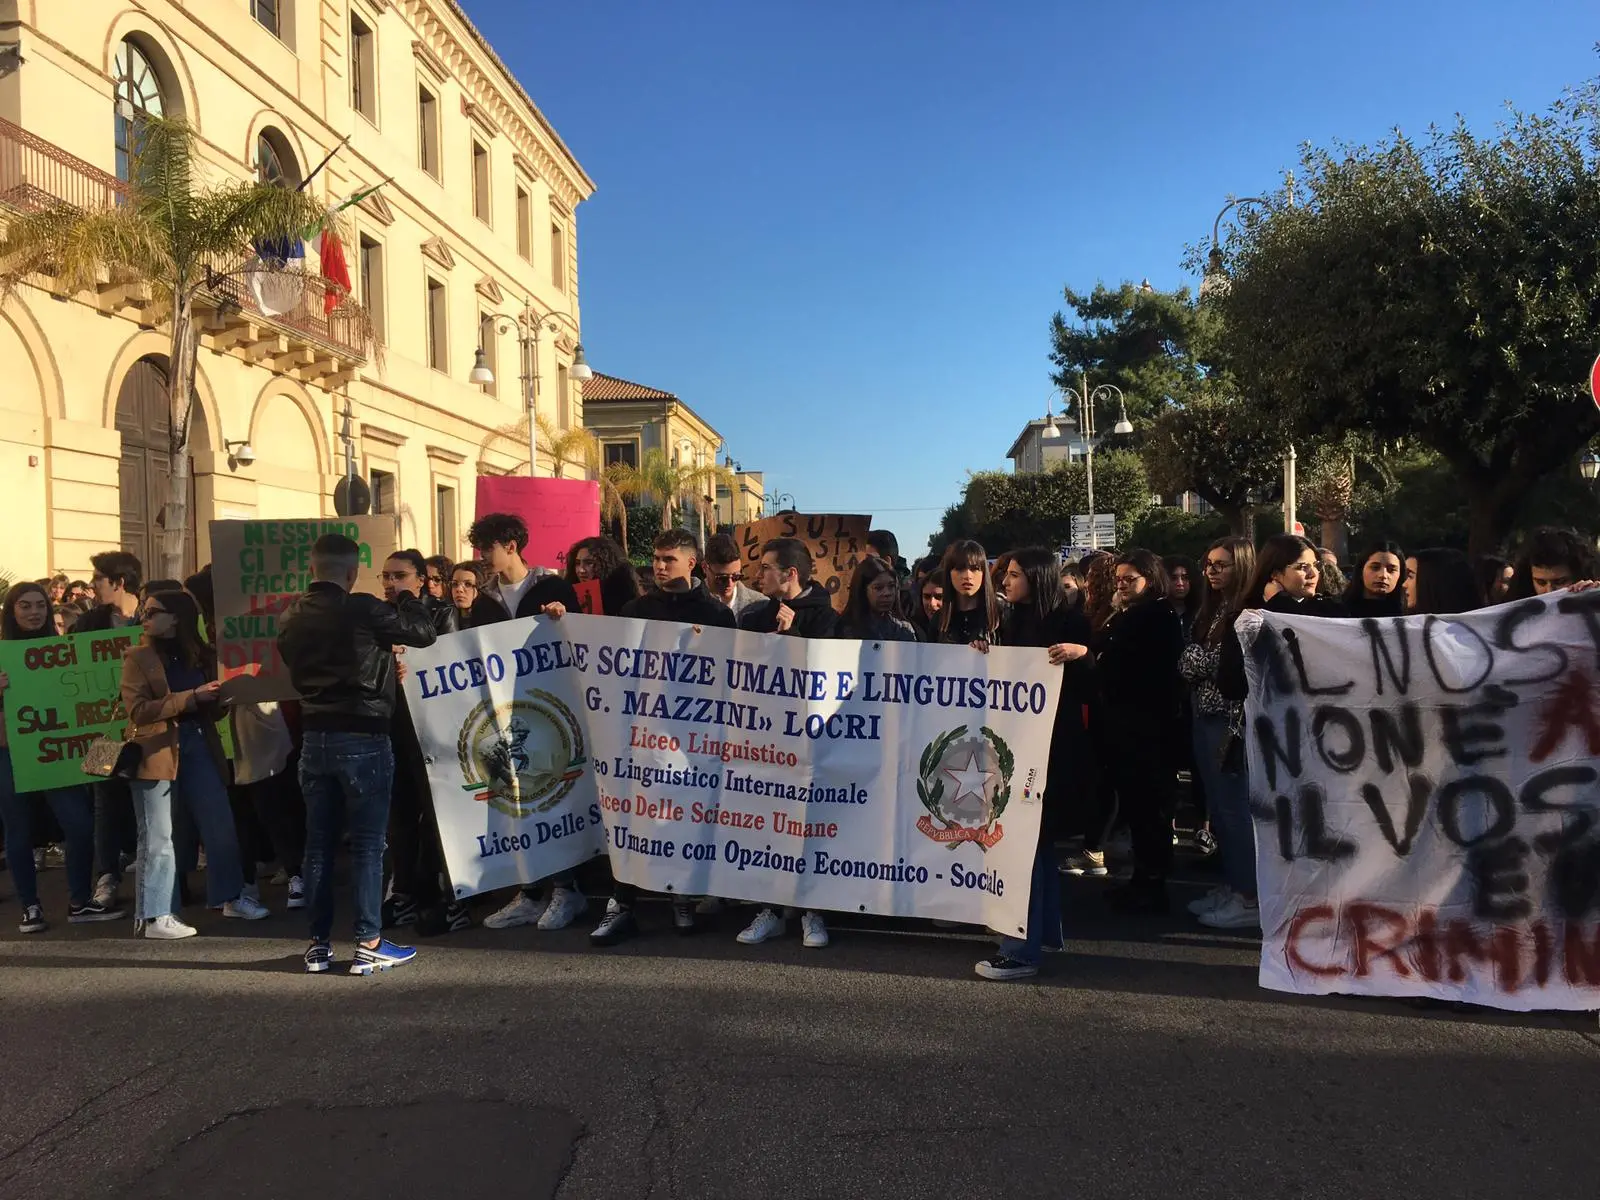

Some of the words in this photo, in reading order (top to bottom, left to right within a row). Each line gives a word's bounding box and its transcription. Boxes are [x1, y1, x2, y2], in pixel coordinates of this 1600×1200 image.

[239, 548, 264, 573] CI
[280, 542, 372, 572] PEA
[416, 653, 505, 699] LICEO
[512, 640, 589, 678] DELLE
[597, 647, 716, 687] SCIENZE
[726, 658, 827, 702] UMANE
[836, 671, 854, 701] E
[863, 671, 1047, 715] LINGUISTICO
[17, 705, 69, 734] SUL
[585, 686, 610, 713] G.
[783, 710, 882, 740] LOCRI
[629, 726, 680, 752] Liceo
[688, 732, 798, 768] Linguistico
[613, 757, 720, 788] Linguistico
[725, 769, 868, 805] Internazionale
[1025, 768, 1035, 788] CAM
[600, 787, 632, 814] iceo
[635, 794, 684, 822] Delle
[691, 801, 765, 831] Scienze
[772, 811, 839, 839] Umane
[476, 833, 531, 859] Liceo
[536, 813, 585, 845] Delle
[614, 825, 675, 858] Umane
[682, 841, 717, 861] con
[724, 839, 807, 875] Opzione
[814, 851, 929, 885] Economico
[950, 862, 1004, 898] Sociale
